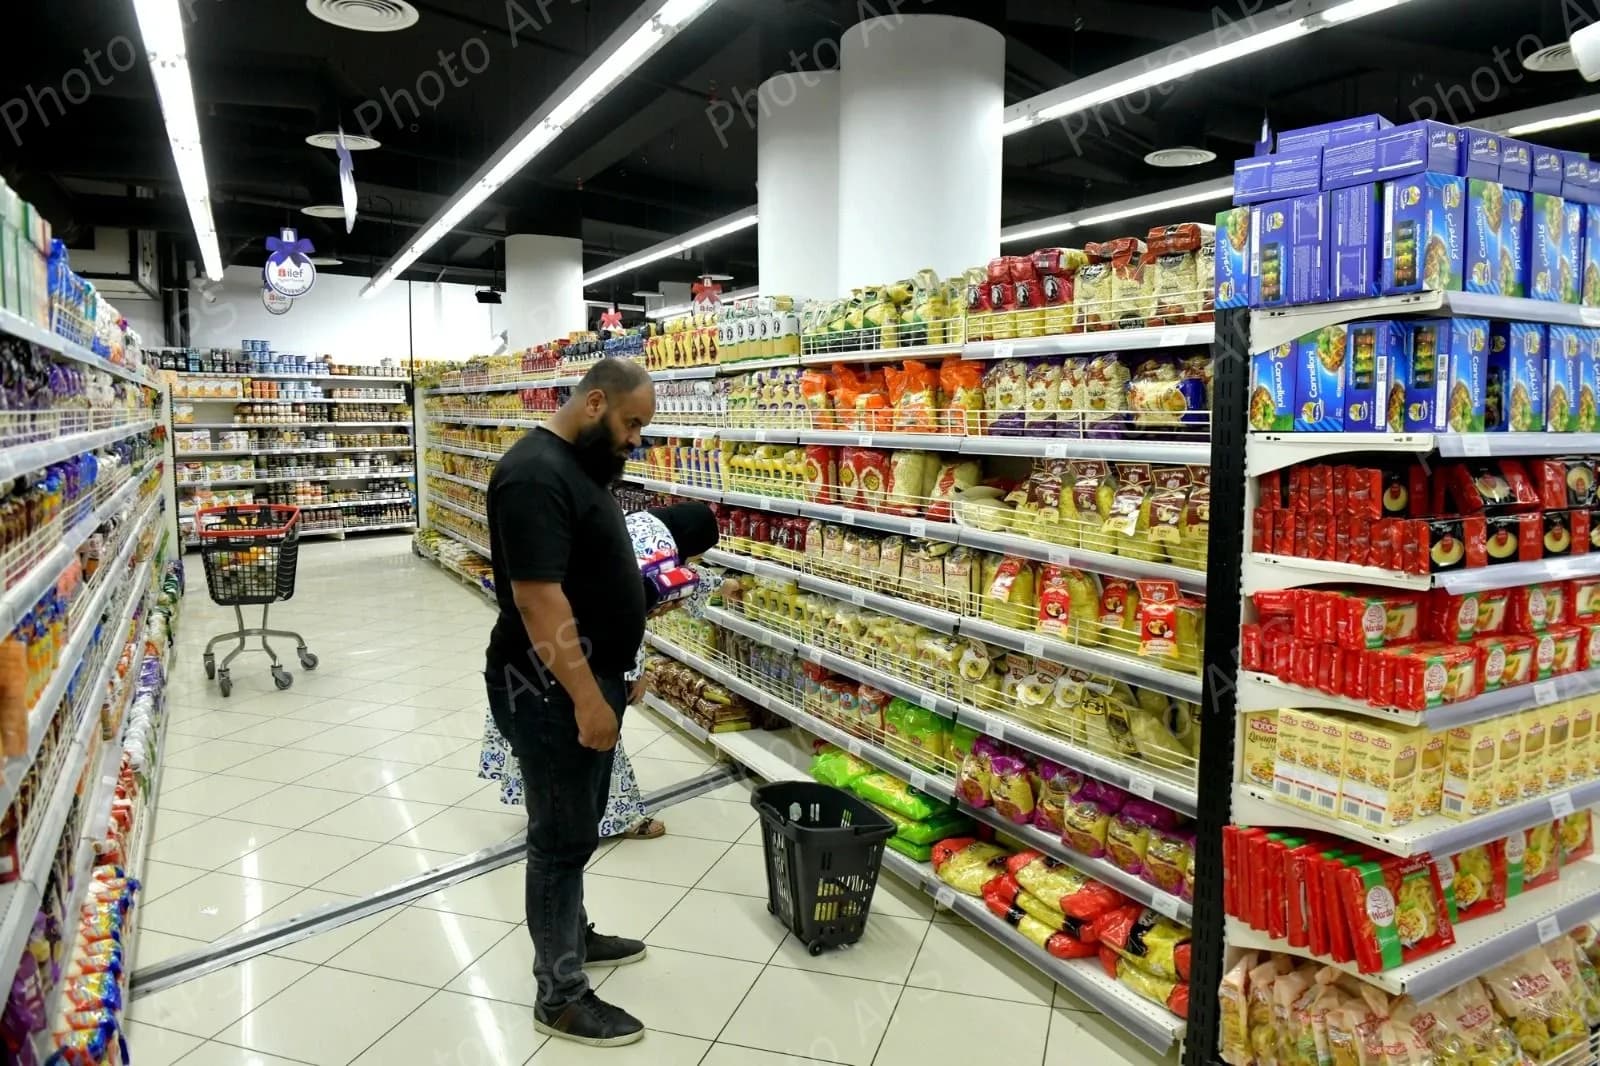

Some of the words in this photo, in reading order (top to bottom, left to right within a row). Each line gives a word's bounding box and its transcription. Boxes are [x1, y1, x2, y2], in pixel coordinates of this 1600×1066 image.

[1274, 361, 1286, 408] Cannelloni
[1306, 350, 1318, 398] Cannelloni
[1371, 907, 1394, 921] Warda
